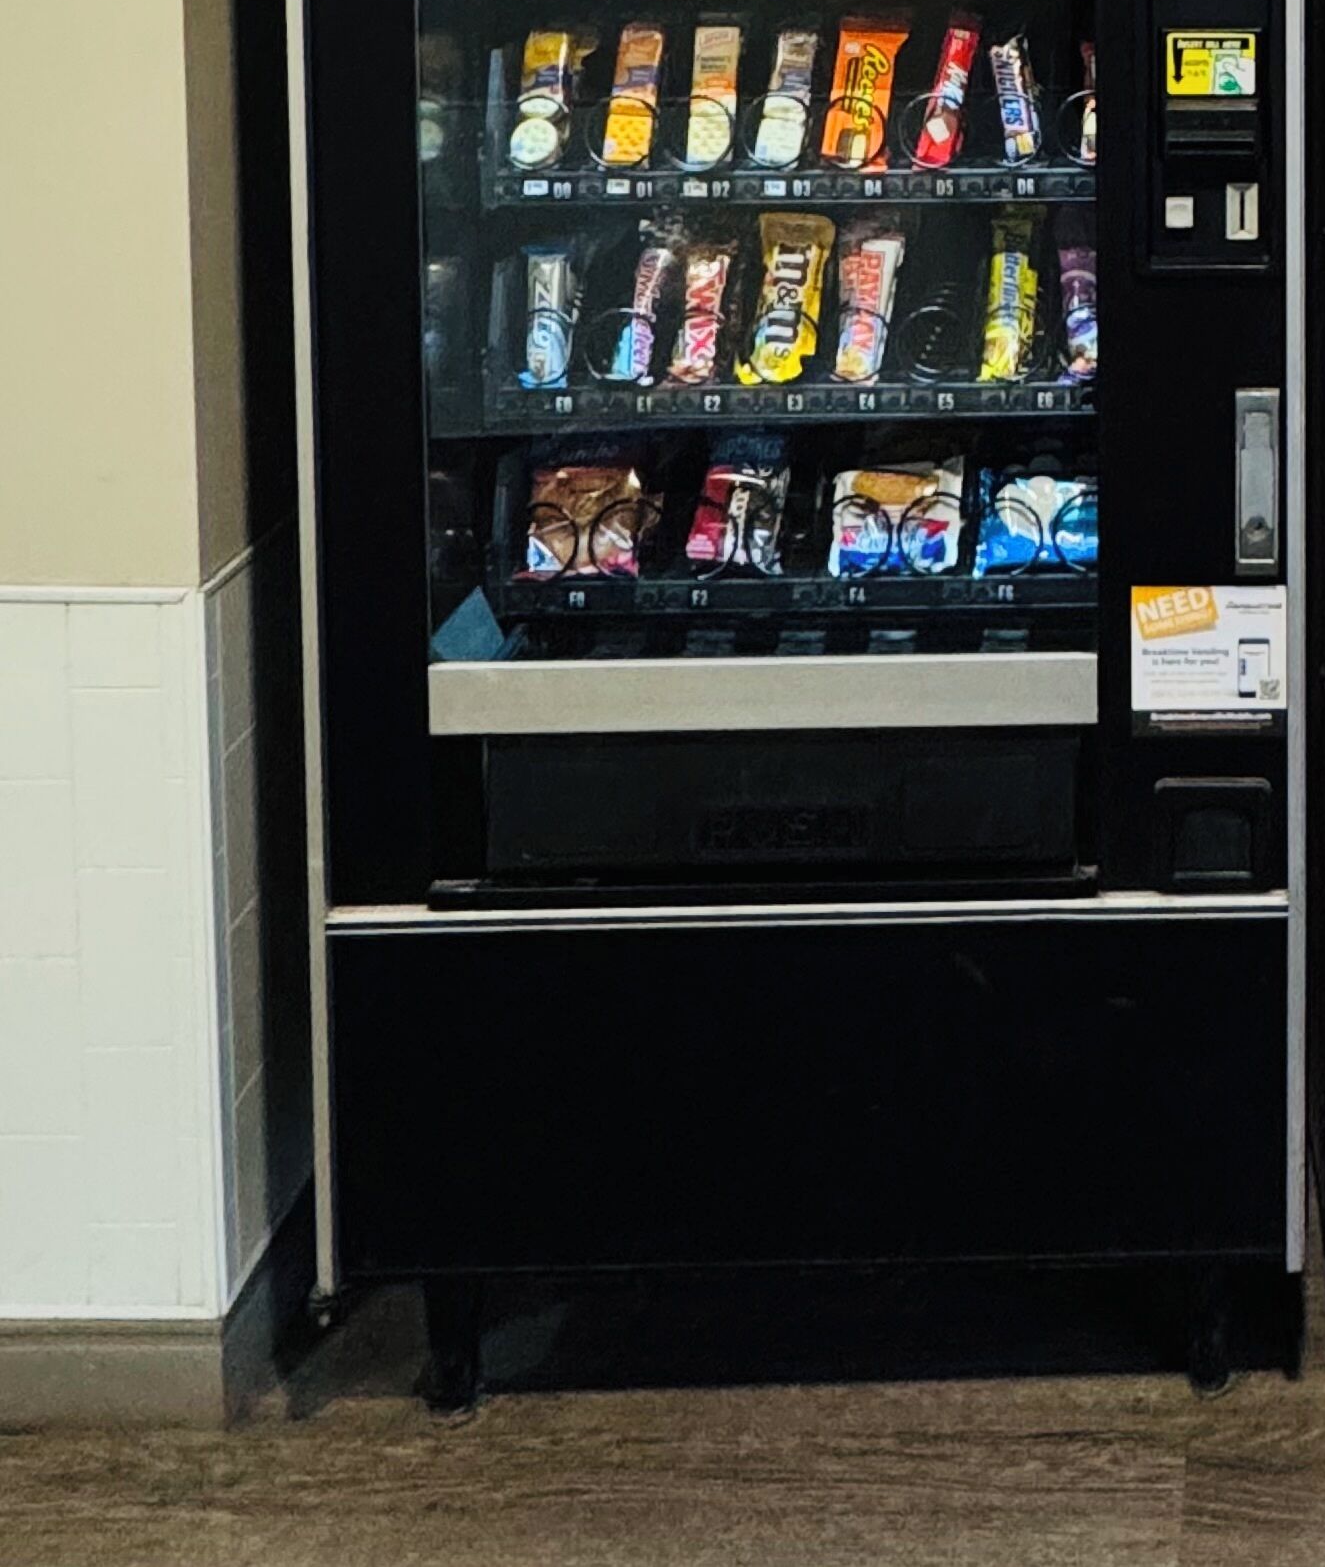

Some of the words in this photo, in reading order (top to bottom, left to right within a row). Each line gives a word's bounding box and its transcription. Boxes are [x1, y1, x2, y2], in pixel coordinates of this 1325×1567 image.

[991, 45, 1024, 127] SNICKERS
[636, 182, 653, 198] D1
[712, 182, 731, 198] D2
[793, 180, 811, 198] D3
[864, 180, 882, 195] D4
[936, 181, 954, 195] D5
[1017, 179, 1035, 194] D6
[851, 250, 882, 350] PAYDAY
[555, 396, 573, 413] E0
[704, 394, 721, 412] E2
[787, 393, 803, 412] E3
[859, 393, 875, 410] E4
[938, 393, 955, 410] E5
[1037, 391, 1054, 409] E6
[691, 590, 708, 607] F2
[850, 587, 866, 603] F4
[1136, 587, 1210, 624] NEED
[1141, 648, 1189, 656] Breaktime
[1191, 648, 1229, 657] Vending
[1161, 658, 1181, 666] here
[1184, 657, 1198, 665] for
